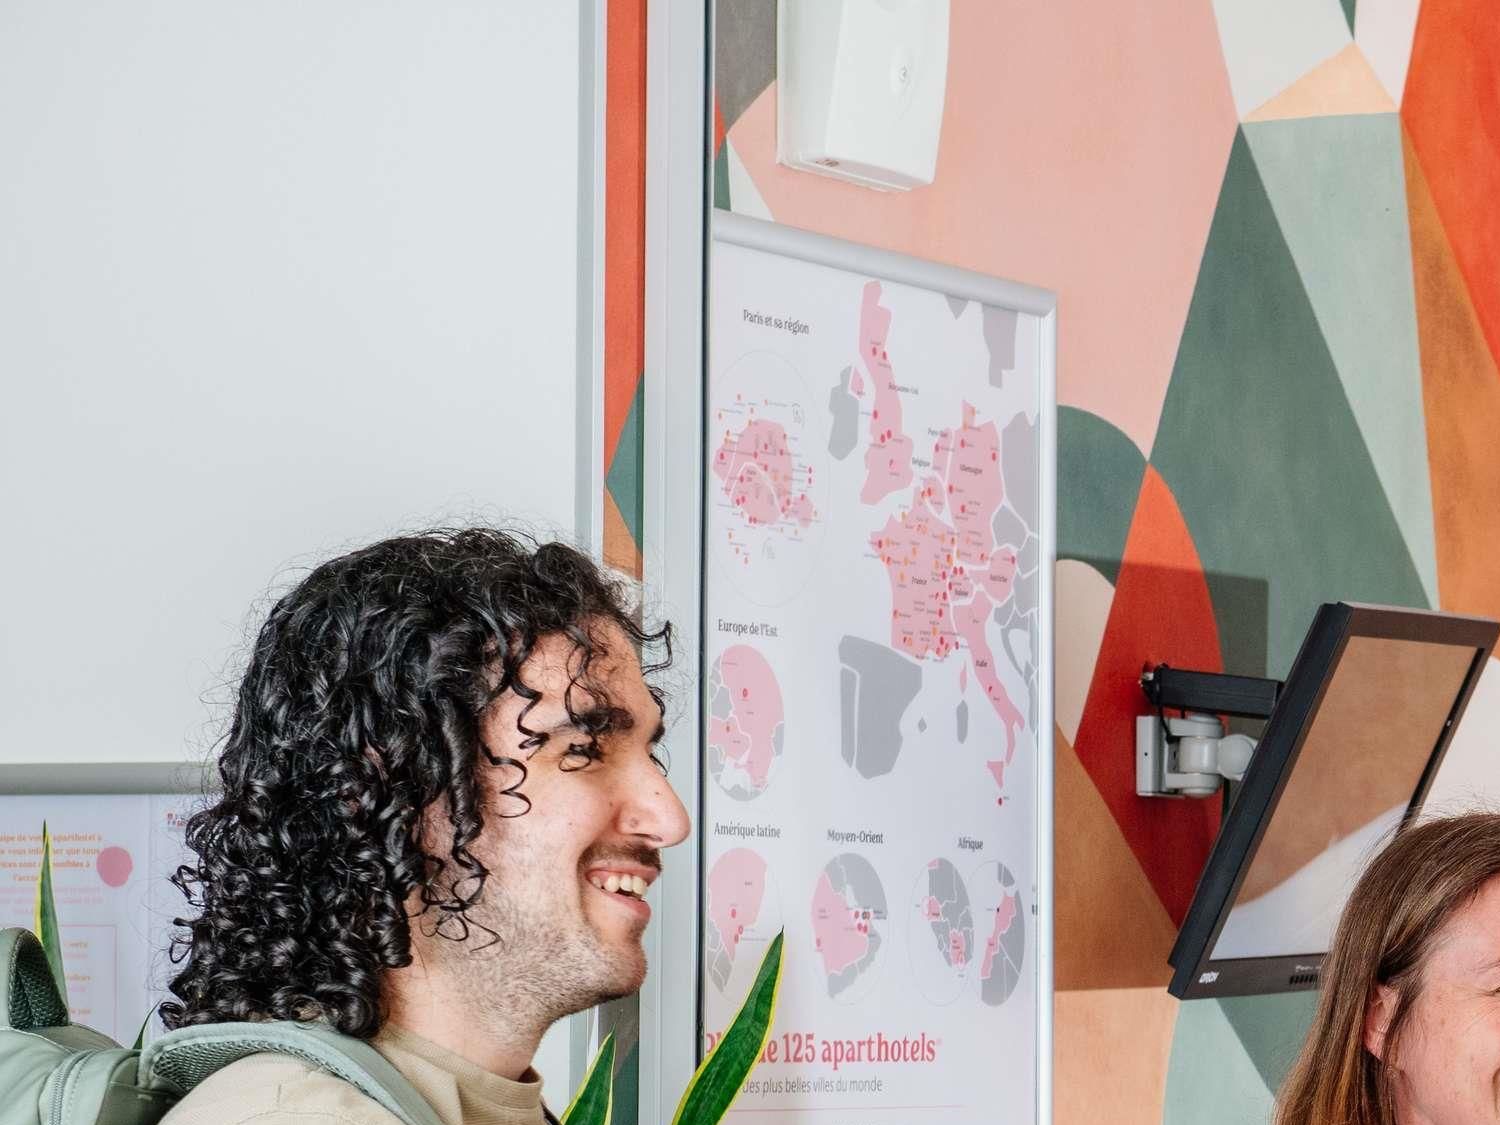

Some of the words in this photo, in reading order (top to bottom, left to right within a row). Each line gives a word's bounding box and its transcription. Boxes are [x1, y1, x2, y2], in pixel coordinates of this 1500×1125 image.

[744, 309, 763, 325] Paris
[764, 317, 773, 327] et
[774, 319, 783, 328] sa
[783, 316, 810, 336] région
[718, 619, 749, 636] Europe
[749, 622, 760, 635] de
[714, 820, 756, 839] Amérique
[757, 824, 781, 838] latine
[827, 829, 884, 845] Moyen-Orient
[957, 837, 984, 852] Afrique
[783, 1033, 816, 1063] 125
[821, 1032, 937, 1072] aparthotels
[763, 1077, 783, 1098] plus
[785, 1076, 812, 1094] belles
[812, 1075, 834, 1093] villes
[835, 1075, 848, 1092] du
[849, 1074, 883, 1093] monde
